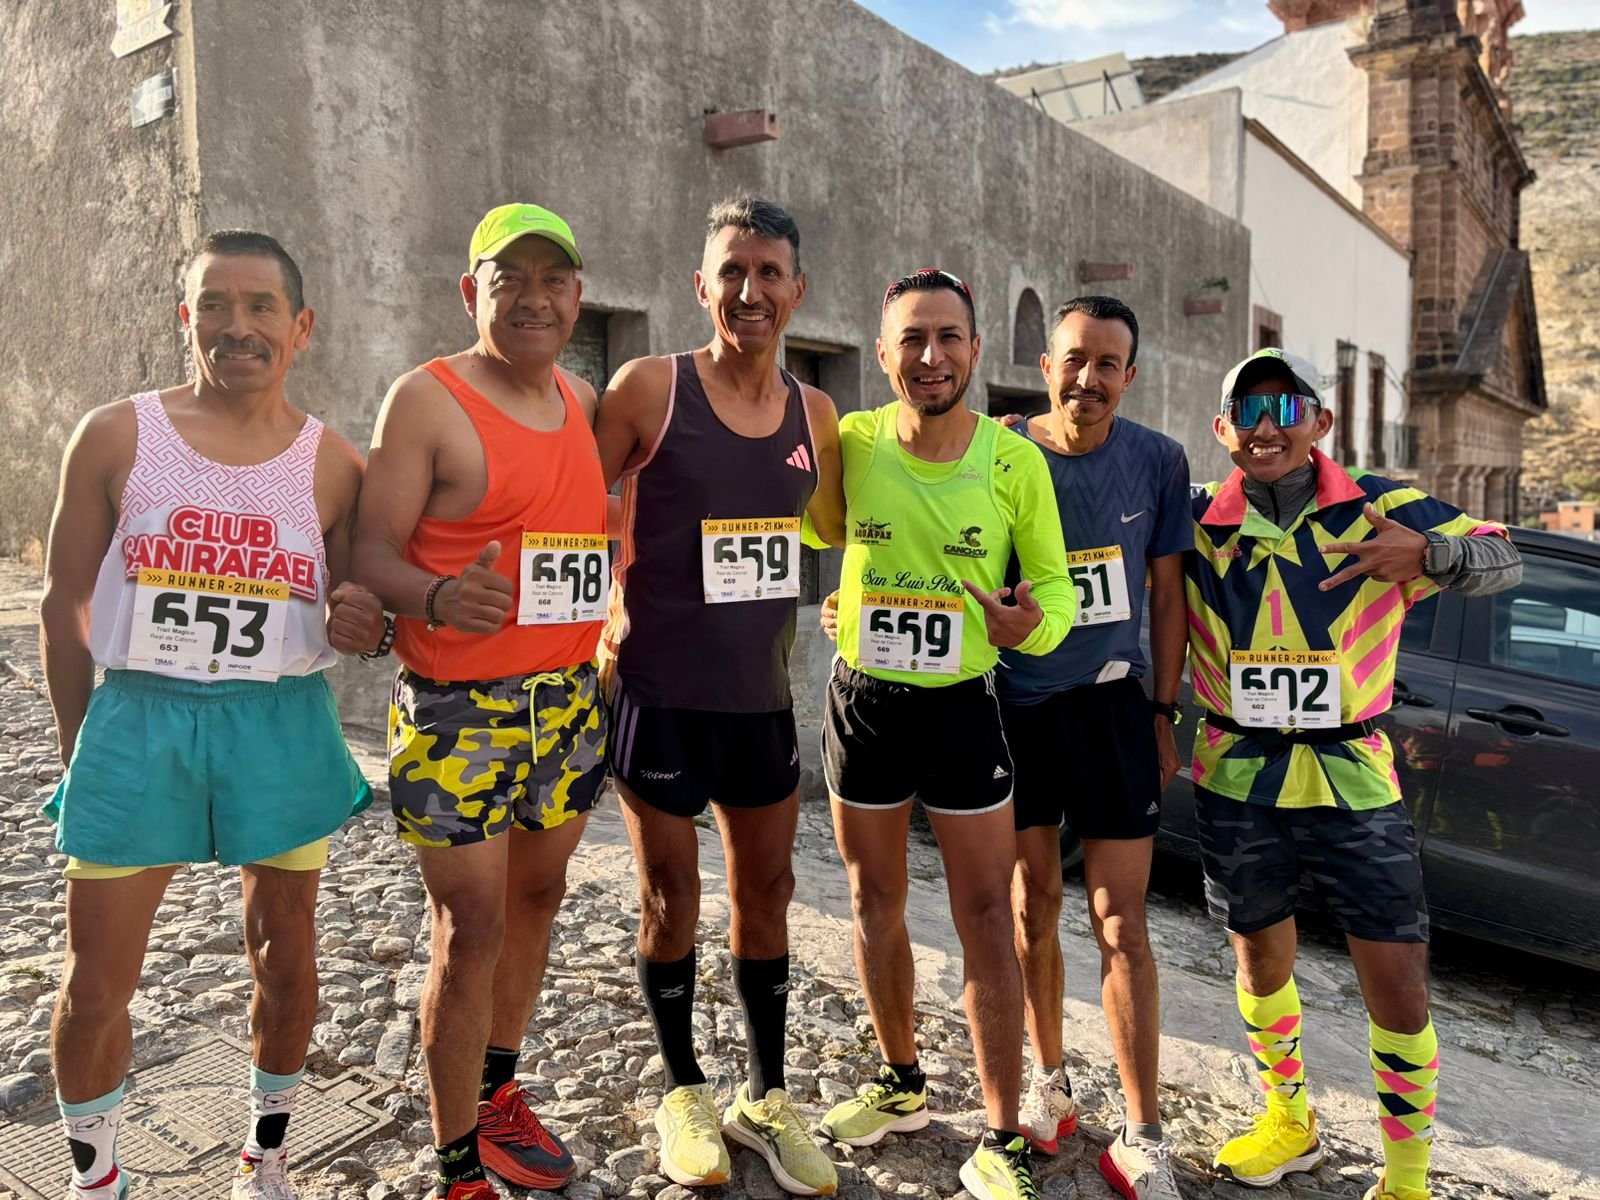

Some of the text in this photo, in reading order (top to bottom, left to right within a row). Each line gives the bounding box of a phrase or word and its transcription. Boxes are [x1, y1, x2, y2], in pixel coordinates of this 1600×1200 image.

[169, 506, 277, 548] CLUB
[722, 521, 784, 531] RUNNER 21 KM
[543, 537, 597, 548] RUNNER 21 KM
[943, 544, 988, 556] CANCHOLA
[1083, 552, 1092, 561] 21
[1093, 551, 1105, 560] KM
[191, 545, 318, 599] RAFAEL
[714, 535, 789, 582] 659
[168, 574, 264, 596] RUNNER 21 KM
[532, 553, 602, 604] 668
[861, 567, 965, 596] San Luis Potos
[1068, 563, 1112, 609] 51
[880, 595, 946, 609] RUNNER 21 KM
[1265, 589, 1284, 637] 1
[152, 592, 270, 658] 653
[156, 626, 170, 635] Trail
[870, 609, 951, 658] 669
[159, 644, 179, 652] 653
[1250, 653, 1320, 663] RUNNER 21 KM
[1241, 667, 1330, 712] 602
